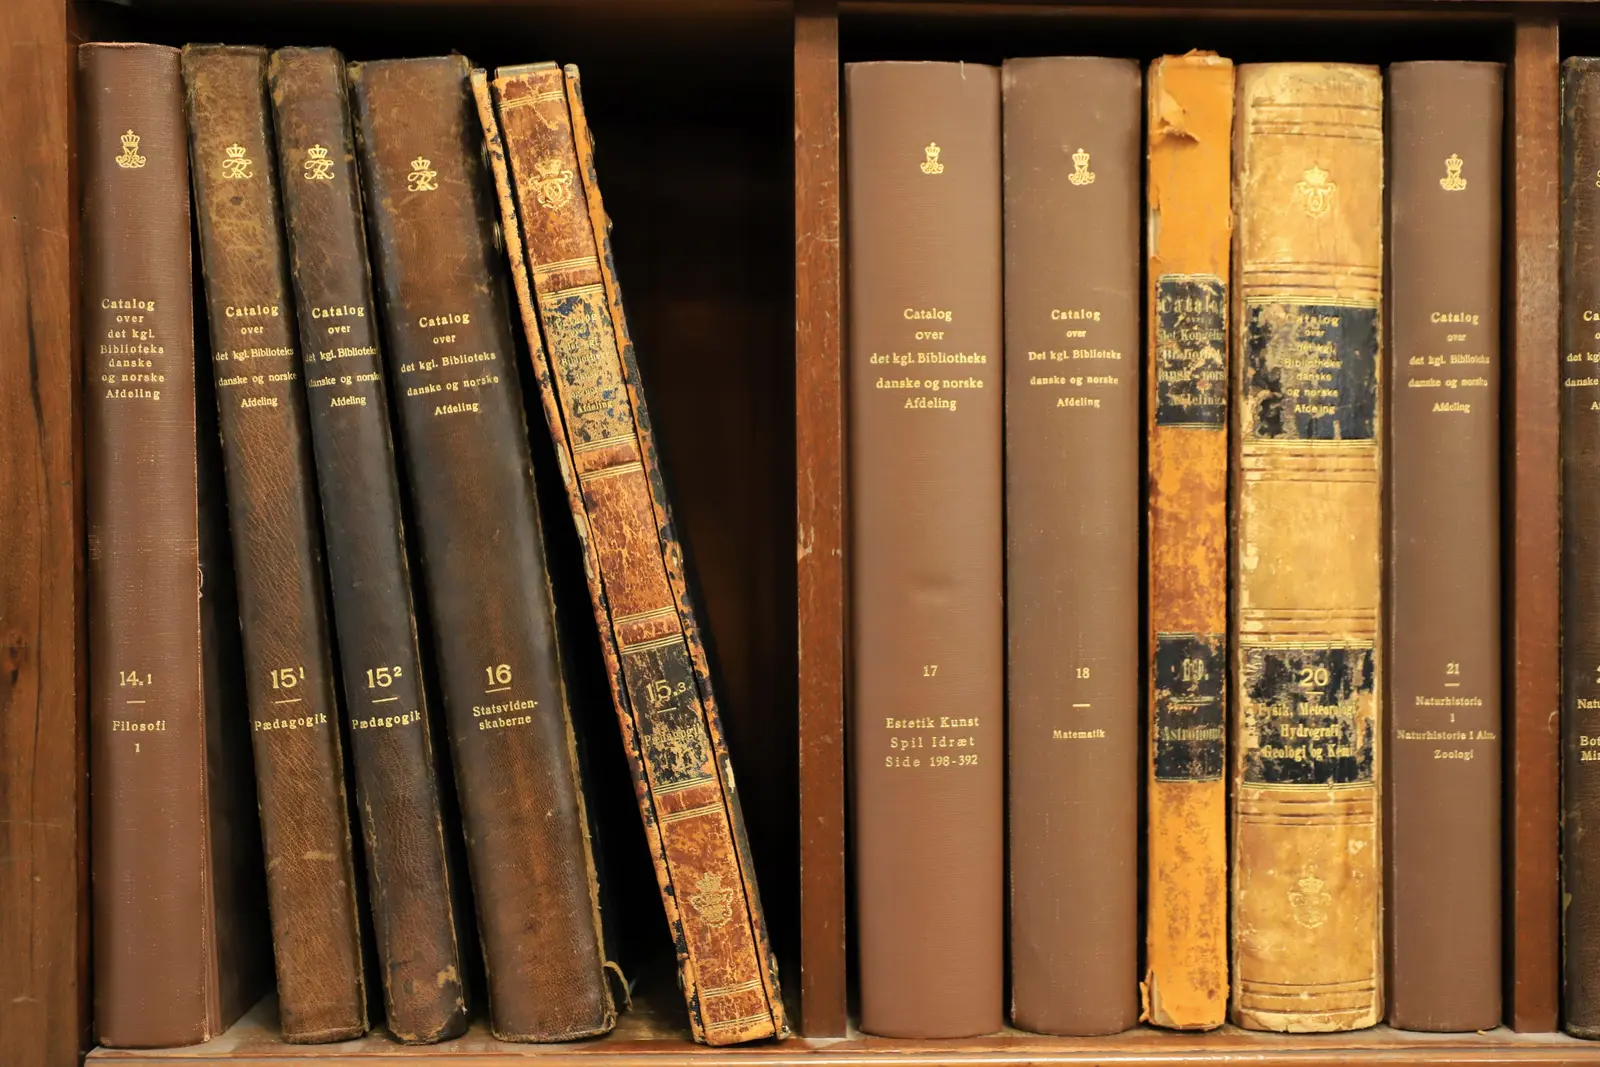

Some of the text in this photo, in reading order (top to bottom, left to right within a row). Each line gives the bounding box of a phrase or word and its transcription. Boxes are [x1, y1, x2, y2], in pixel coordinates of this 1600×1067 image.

[102, 298, 155, 311] Catalog
[226, 304, 278, 318] Catalog
[312, 304, 364, 318] Catalog
[904, 308, 952, 322] Catalog
[1051, 308, 1100, 322] Catalog
[419, 313, 470, 328] Catalog
[1430, 312, 1479, 325] Catalog
[108, 328, 155, 340] det kgl.
[241, 326, 264, 335] over
[328, 326, 350, 334] over
[915, 331, 944, 340] over
[1066, 330, 1086, 338] over
[1304, 329, 1326, 337] over
[433, 334, 456, 344] over
[1447, 334, 1467, 342] over
[100, 344, 164, 354] Biblioteks
[216, 346, 294, 362] det kgl. Biblioteks
[320, 350, 336, 362] kgl.
[870, 352, 987, 366] det kgl. Bibliotheks
[1028, 349, 1122, 362] Det kgl. Biblioteks
[1409, 354, 1490, 366] det kgl. Biblioteks
[1566, 352, 1582, 362] det
[108, 358, 152, 368] danske
[400, 352, 496, 373] det kgl. Biblioteks
[102, 372, 165, 384] og norske
[218, 372, 297, 386] danske og norske
[308, 376, 336, 388] danske
[340, 376, 352, 385] og
[1030, 375, 1118, 386] danske og norske
[1296, 372, 1332, 381] danske
[1564, 376, 1599, 387] danske
[407, 374, 499, 396] danske og norske
[876, 377, 984, 391] danske og norske
[1408, 378, 1442, 388] danske
[1445, 378, 1458, 388] og
[106, 388, 160, 400] Afdeling
[1287, 388, 1339, 398] og norske
[241, 397, 278, 408] Afdeling
[330, 396, 366, 408] Afdeling
[904, 396, 957, 411] Afdeling
[1056, 396, 1100, 408] Afdeling
[1168, 393, 1222, 406] deling
[434, 402, 478, 416] Afdeling
[1294, 404, 1336, 414] Afdeing
[1432, 402, 1471, 414] Afdeling
[923, 664, 938, 677] 17
[1076, 666, 1090, 679] 18
[1446, 662, 1460, 675] 21
[486, 664, 512, 686] 16
[1300, 667, 1329, 687] 20
[1416, 696, 1482, 706] Naturhistorie
[472, 700, 538, 717] Statsviden-
[112, 720, 166, 732] Filosofi
[254, 712, 328, 732] Pædagogik
[352, 710, 422, 730] Pædagogik
[479, 715, 532, 730] skaberne
[886, 716, 980, 728] Estetik Kunst
[1052, 728, 1106, 739] Matematik
[1396, 730, 1466, 740] Naturhistorie
[134, 742, 140, 752] 1
[890, 736, 975, 751] Spil Idræt
[1262, 744, 1306, 762] Geologi
[1310, 746, 1323, 762] og
[1434, 749, 1474, 761] Zoologi
[885, 754, 978, 768] Side 198-392
